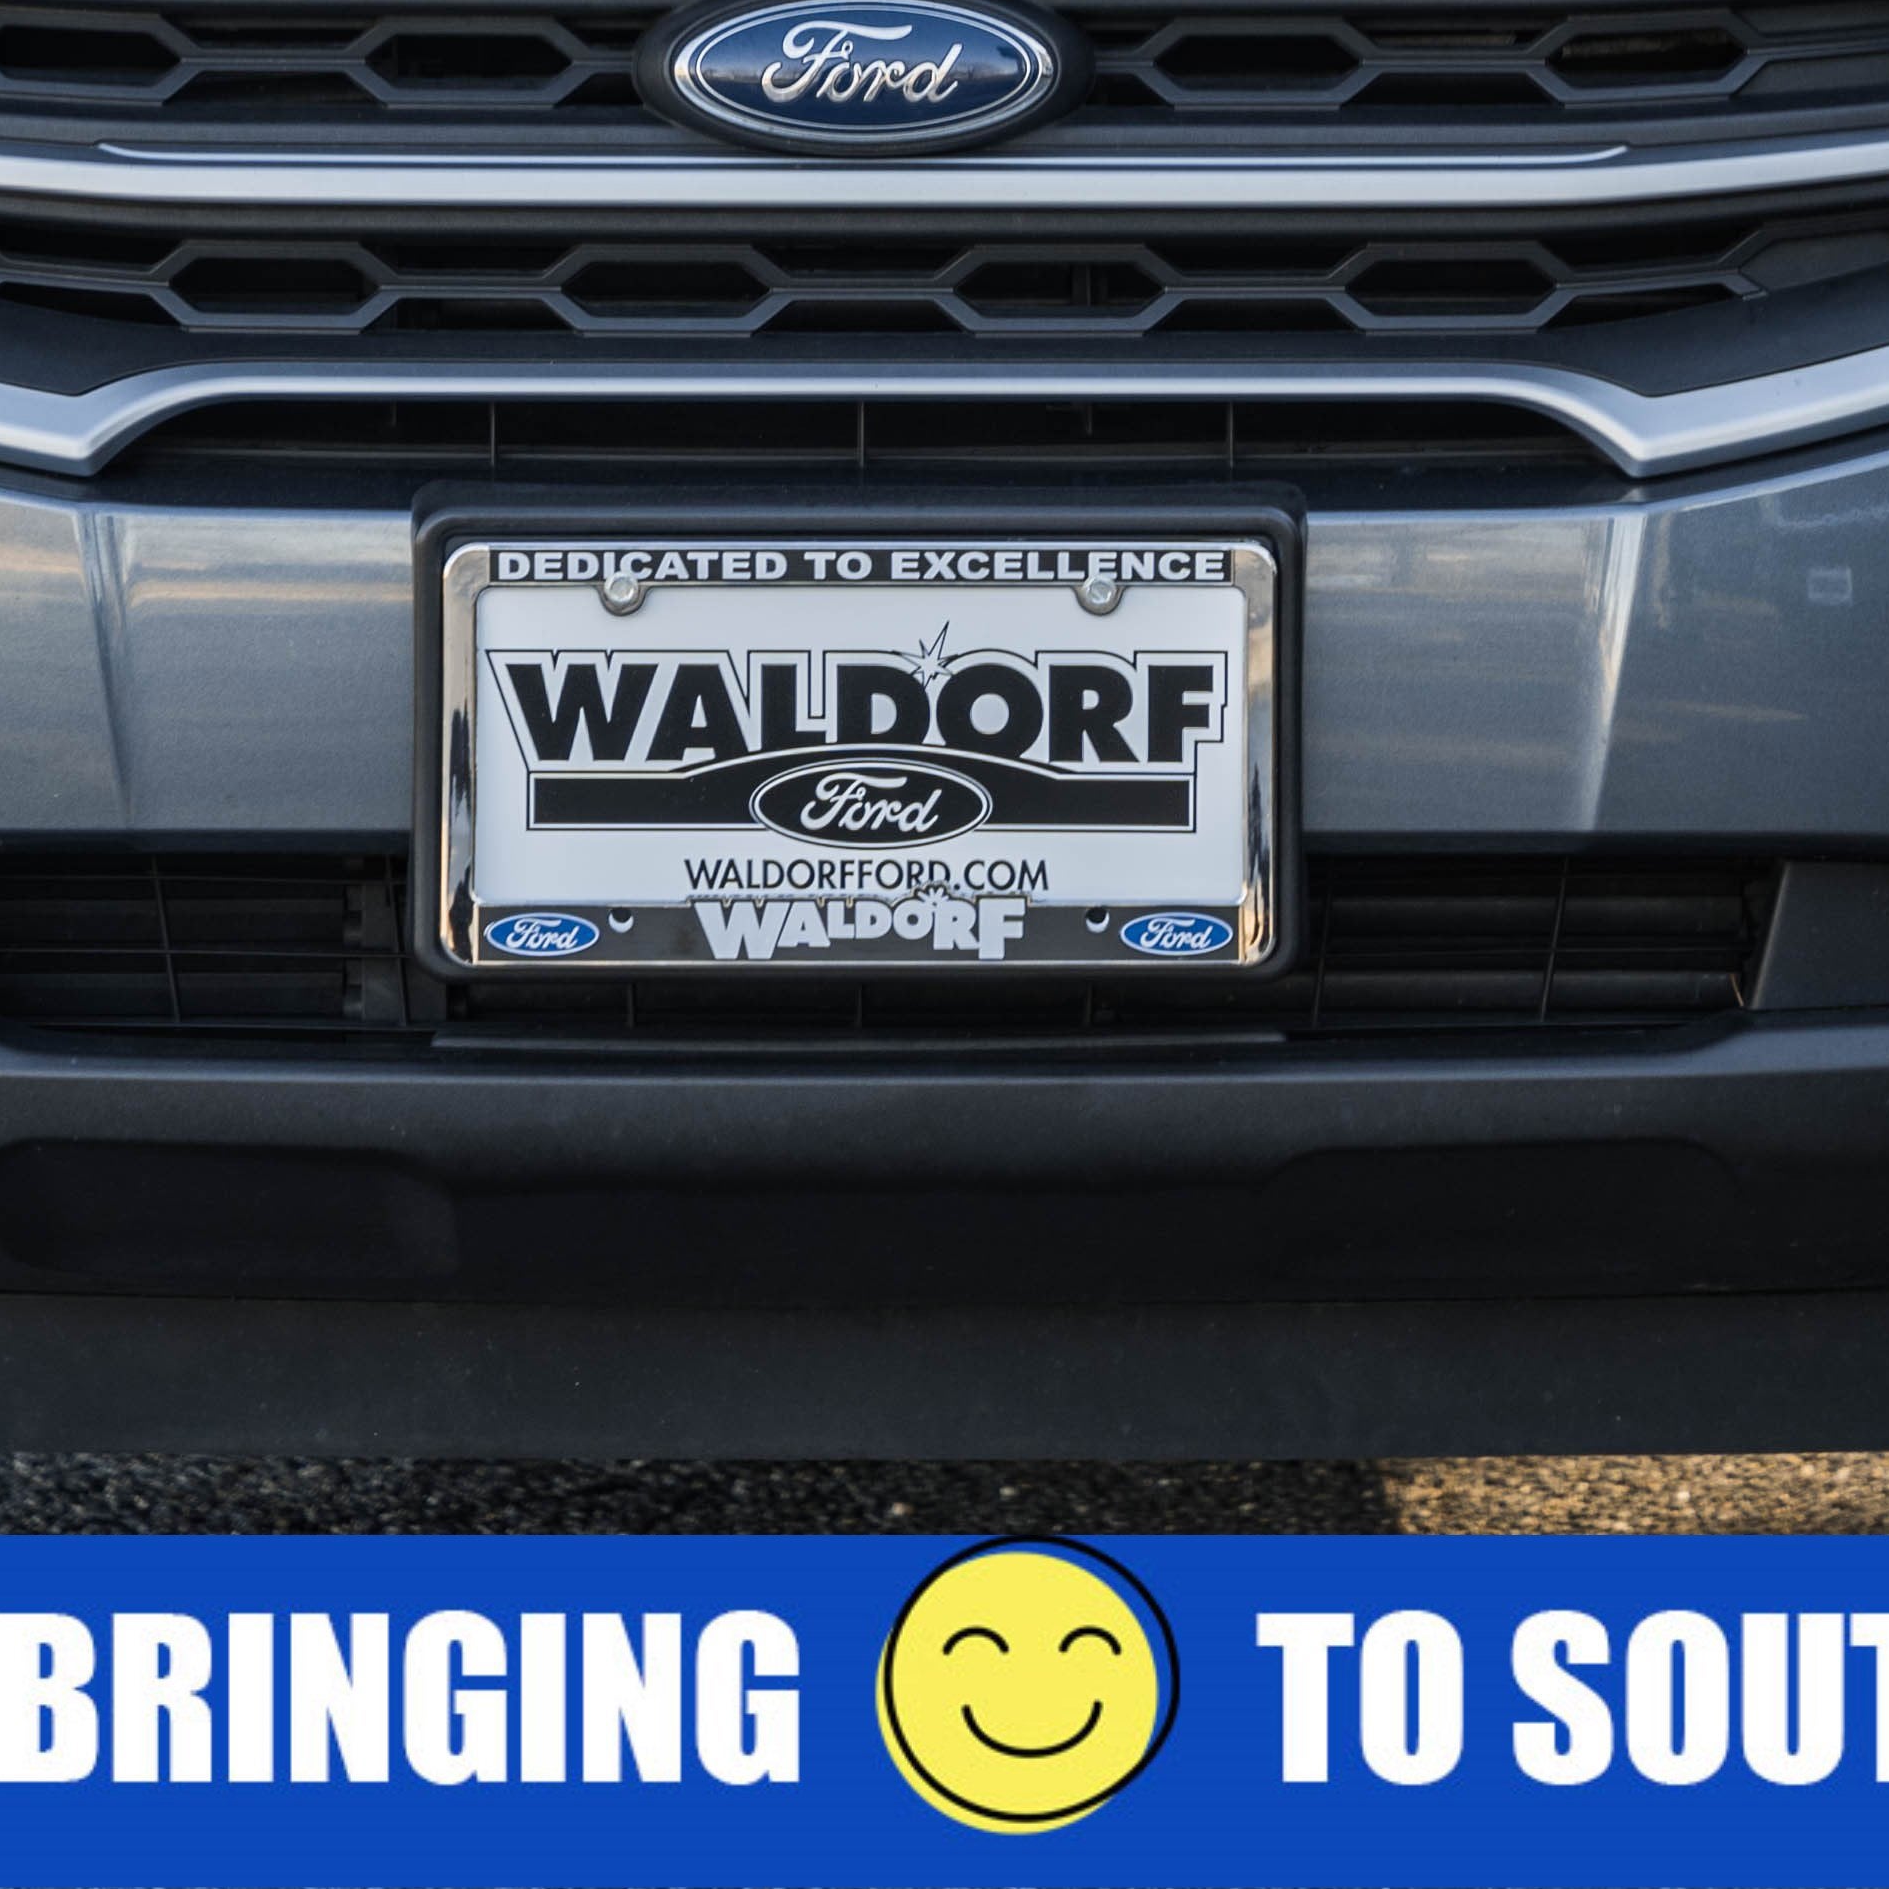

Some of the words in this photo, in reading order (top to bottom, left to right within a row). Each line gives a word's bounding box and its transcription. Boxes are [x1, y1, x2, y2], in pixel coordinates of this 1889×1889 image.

[762, 20, 963, 103] Ford
[498, 551, 788, 580] DEDICATED
[804, 551, 872, 580] TO
[891, 551, 1225, 580] EXCELLENCE
[506, 663, 1214, 764] WALDORF
[800, 772, 943, 833] Ford
[684, 859, 1049, 891] WALDORFFORD.COM
[505, 917, 580, 949] Ford
[693, 898, 1027, 960] WALDORF
[1140, 917, 1214, 949] Ford
